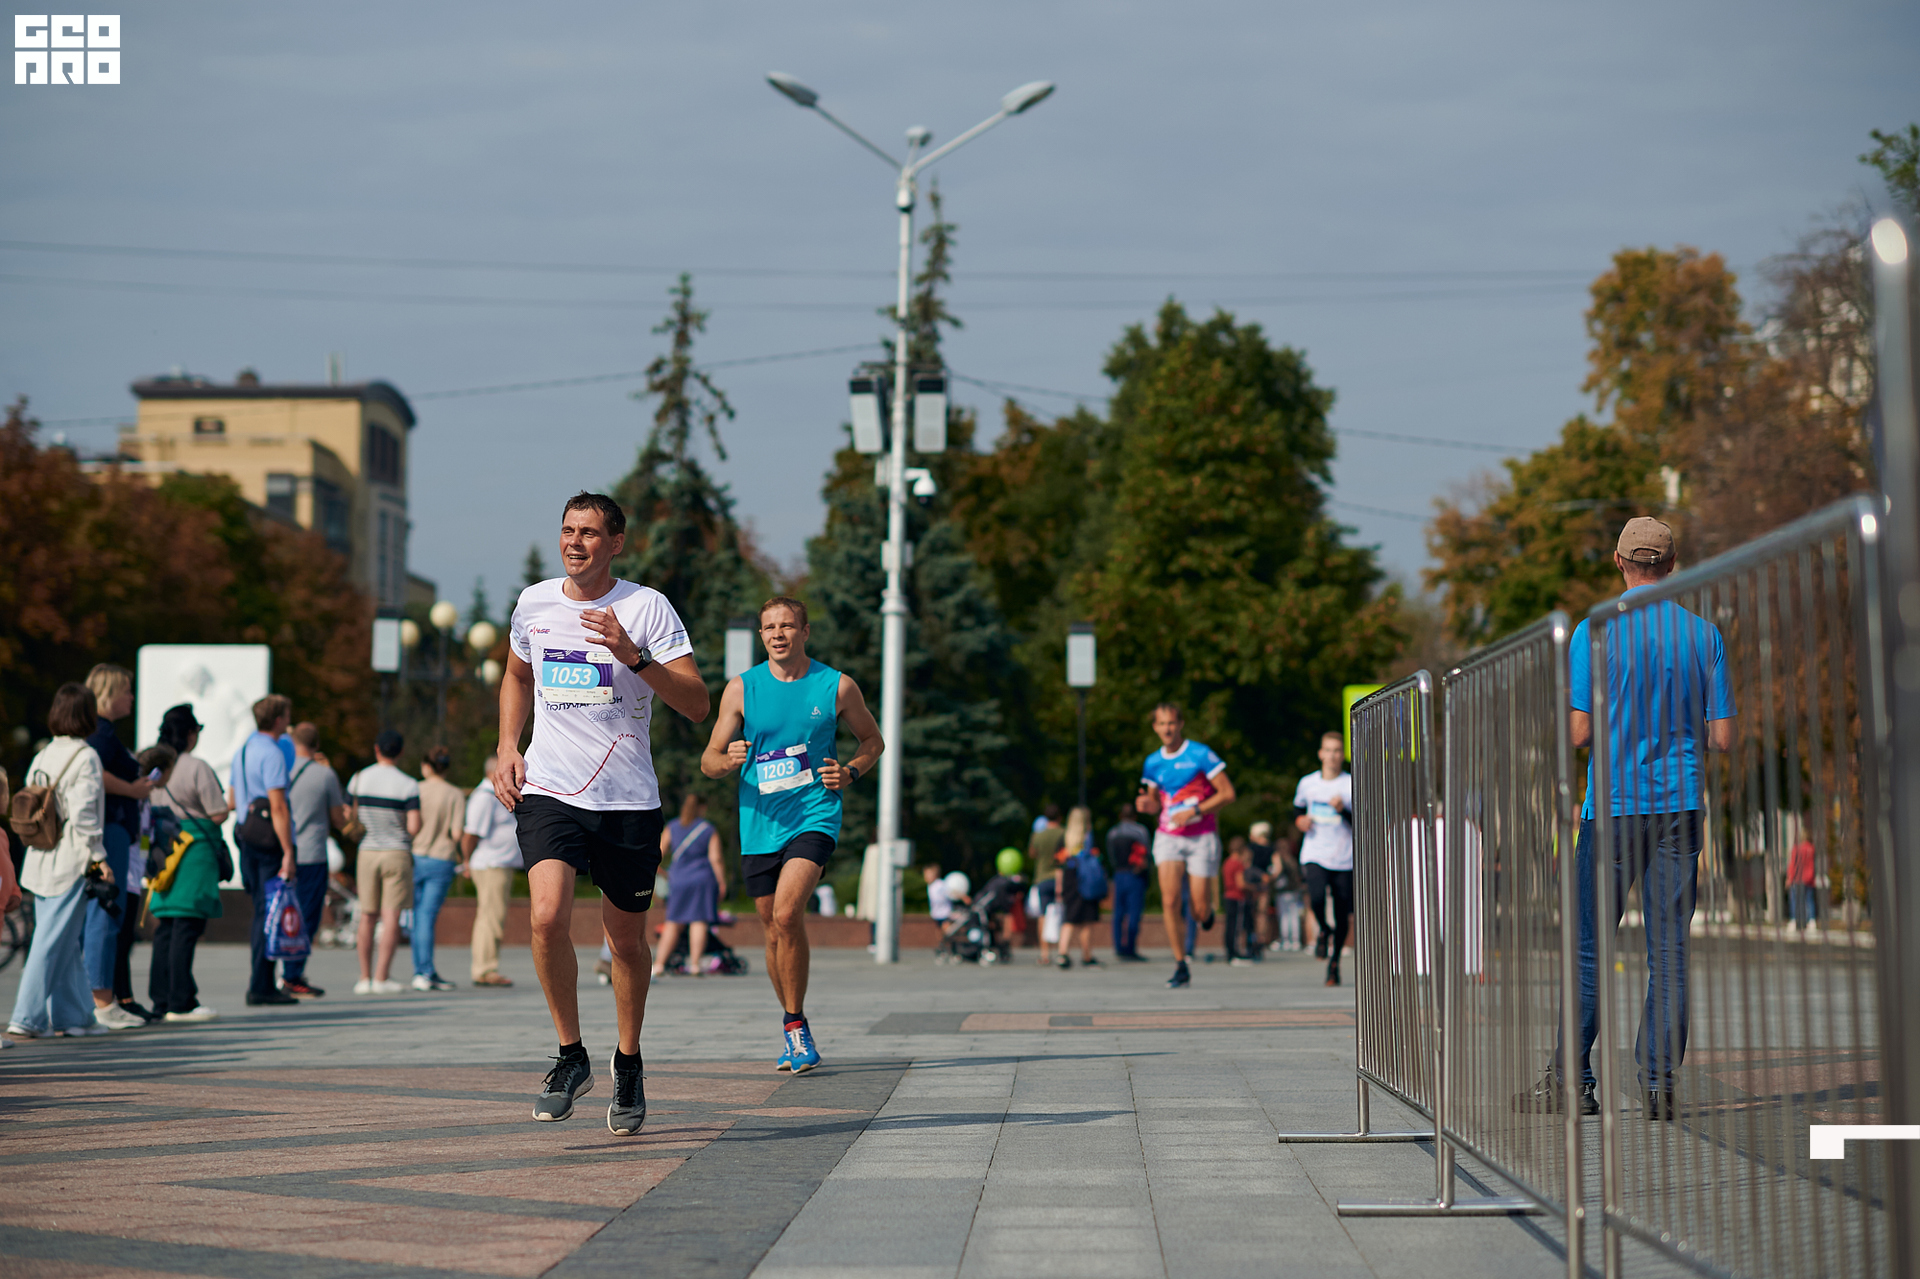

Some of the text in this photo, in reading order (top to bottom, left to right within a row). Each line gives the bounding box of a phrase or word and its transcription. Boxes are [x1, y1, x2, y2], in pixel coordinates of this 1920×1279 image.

[551, 666, 592, 686] 1053
[588, 707, 626, 723] 2021
[762, 760, 795, 780] 1203
